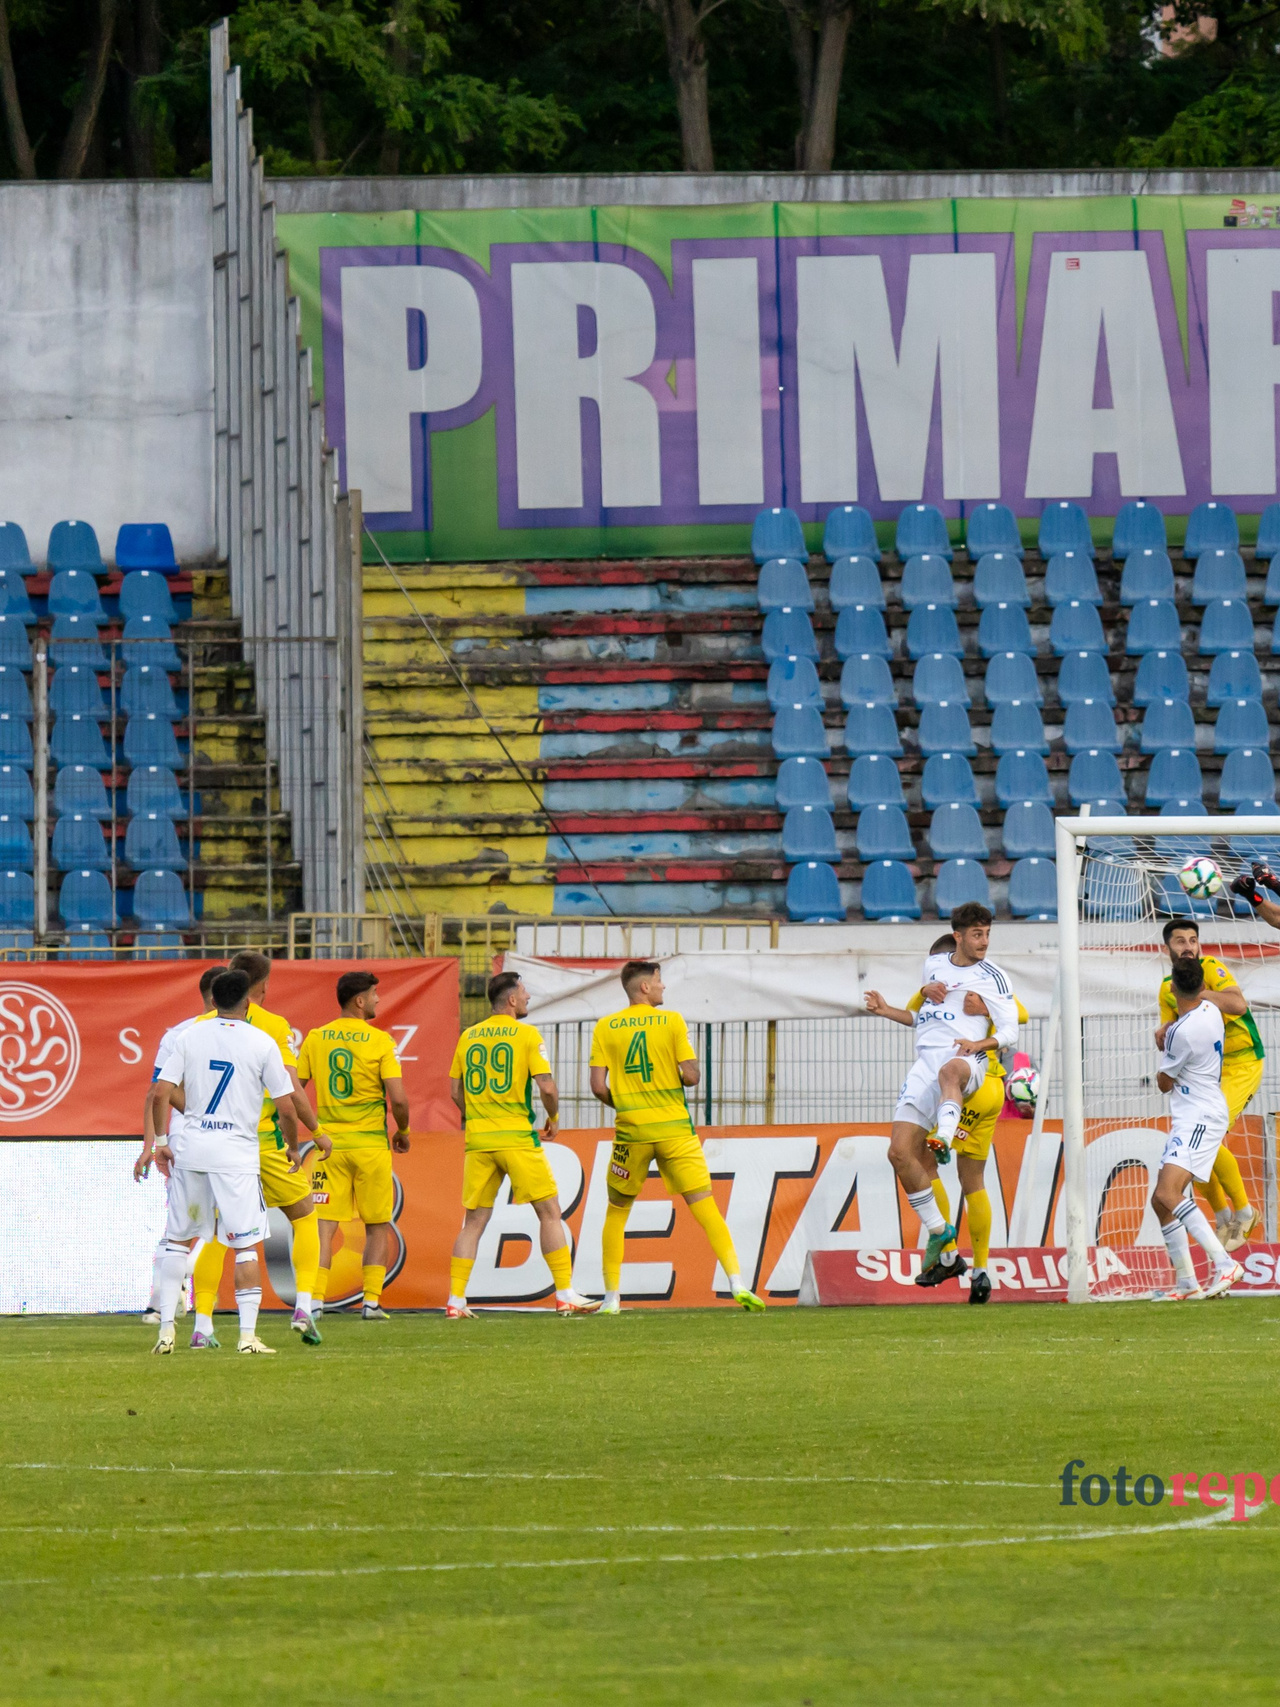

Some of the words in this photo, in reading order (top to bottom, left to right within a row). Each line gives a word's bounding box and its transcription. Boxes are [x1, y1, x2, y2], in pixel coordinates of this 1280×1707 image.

[609, 1015, 667, 1029] GARUTTI
[322, 1029, 370, 1042] TRASCU
[468, 1027, 518, 1039] BLANARU
[624, 1031, 654, 1083] 4
[328, 1047, 353, 1099] 8
[465, 1042, 514, 1095] 89
[209, 1060, 235, 1115] 7
[200, 1121, 234, 1131] MAILAT
[612, 1164, 629, 1179] NOY
